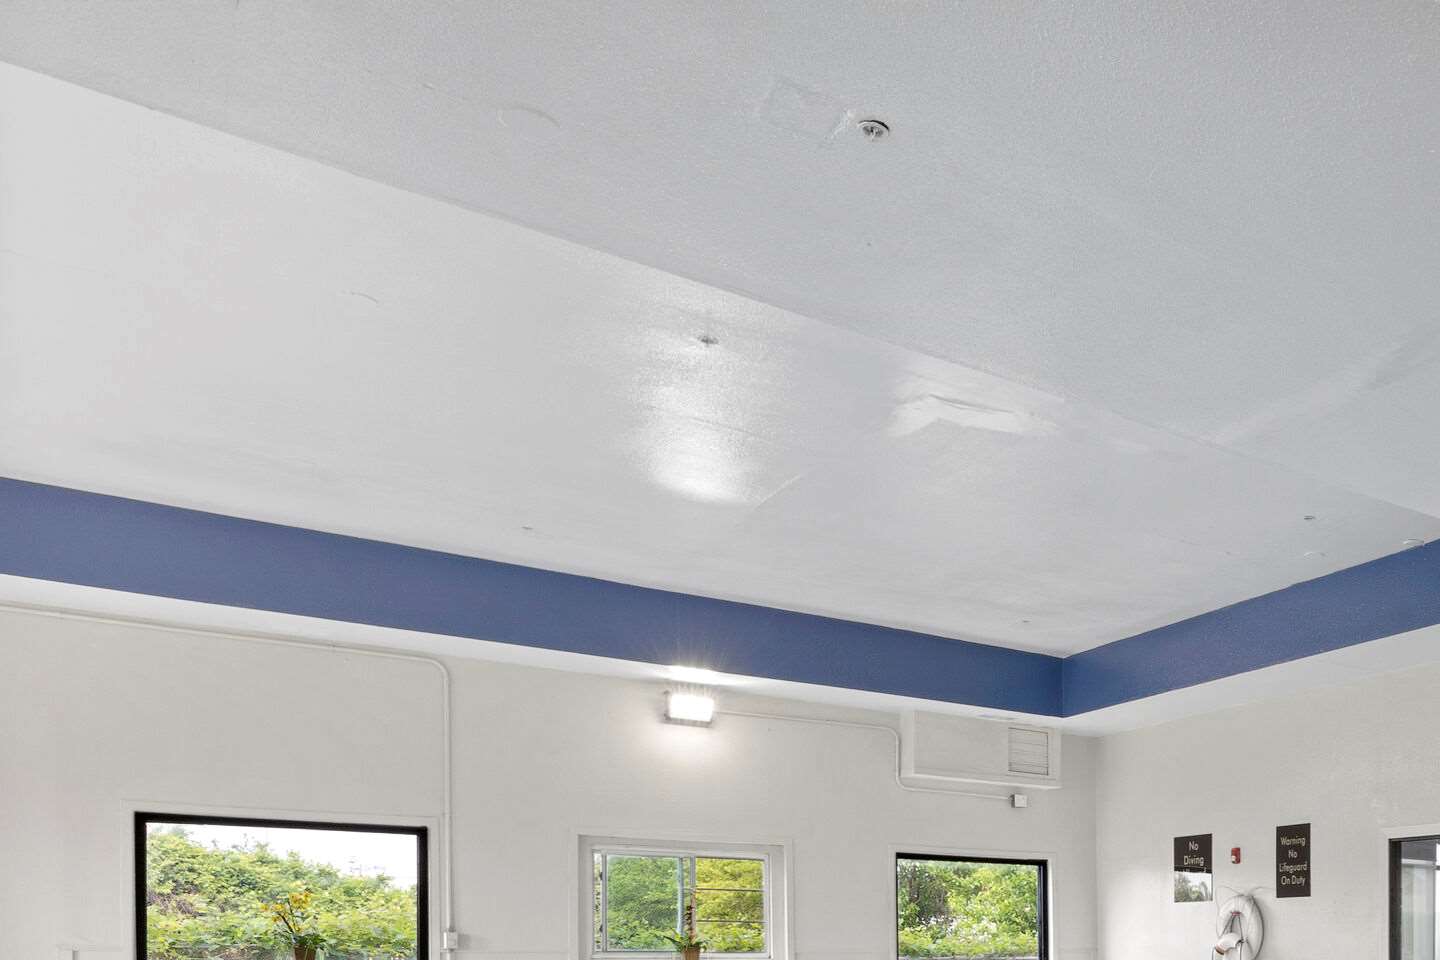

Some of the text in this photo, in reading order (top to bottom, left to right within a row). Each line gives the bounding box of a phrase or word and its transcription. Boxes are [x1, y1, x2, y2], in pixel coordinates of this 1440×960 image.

[1189, 841, 1199, 851] No
[1280, 836, 1306, 846] Warning
[1288, 850, 1298, 858] No
[1183, 854, 1205, 867] Diving
[1279, 861, 1307, 873] Lifeguard
[1281, 875, 1305, 886] On Duty
